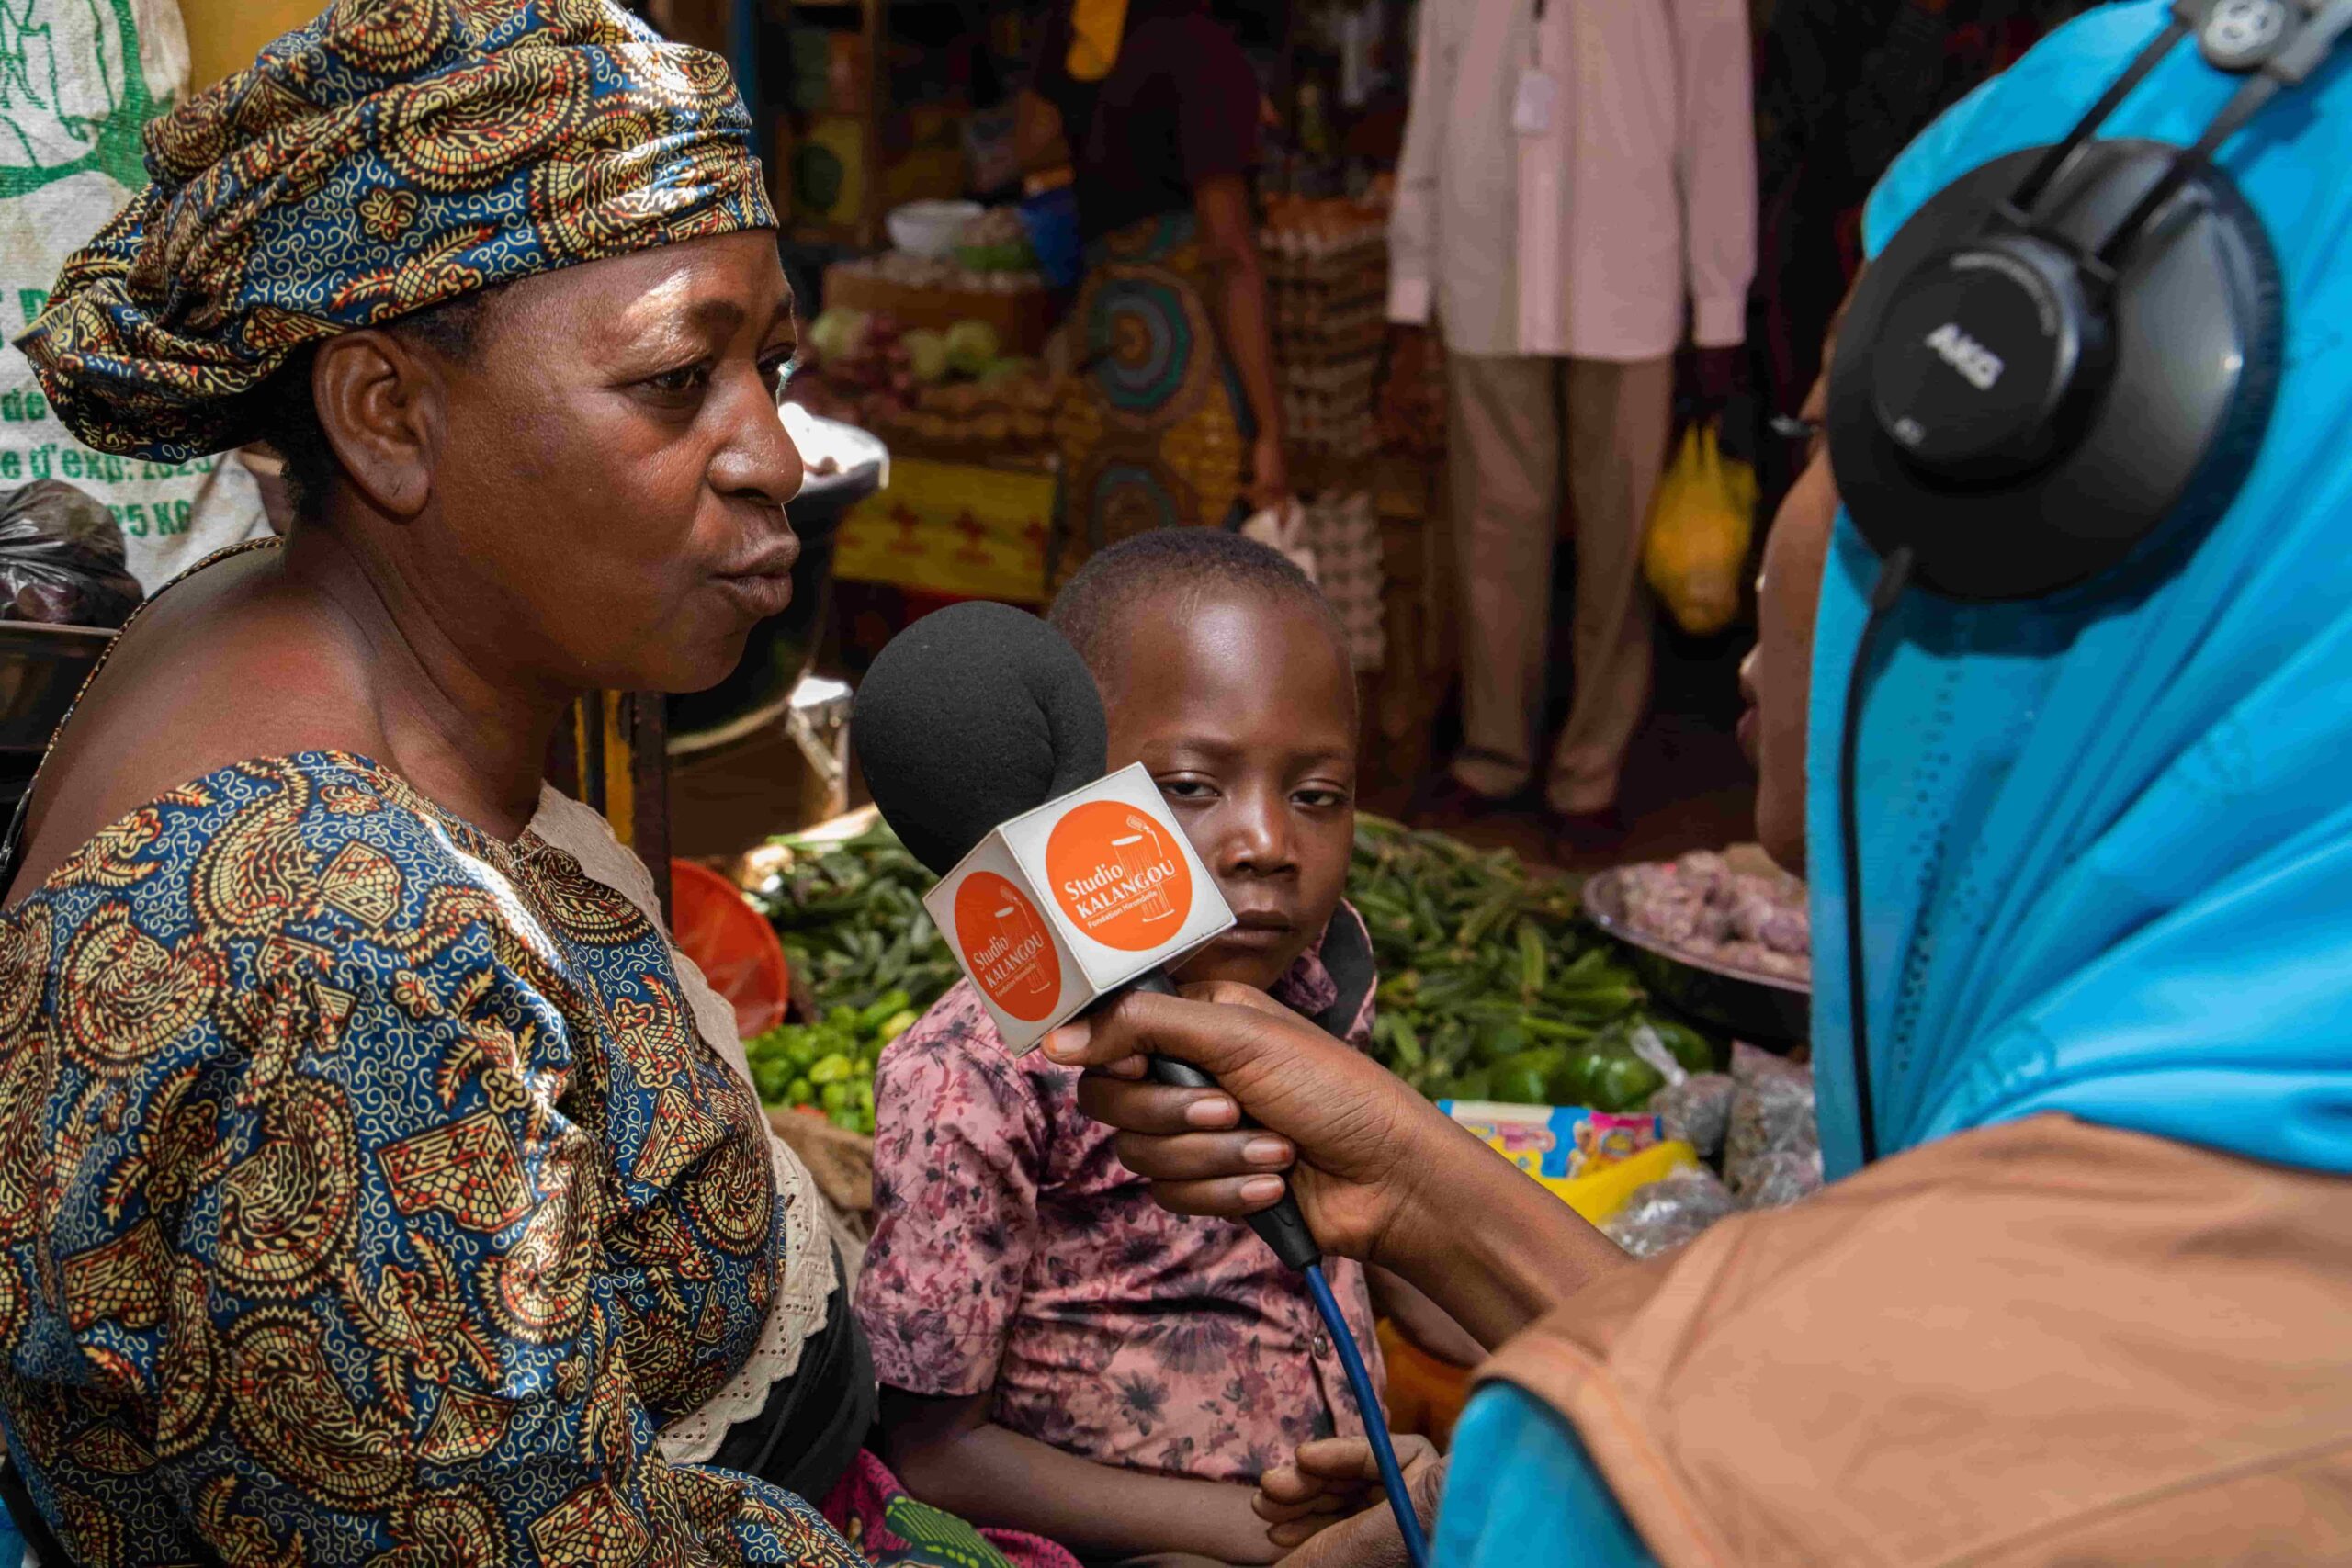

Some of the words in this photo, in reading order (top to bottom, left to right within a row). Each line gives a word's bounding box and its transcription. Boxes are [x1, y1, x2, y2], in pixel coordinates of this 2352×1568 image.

[1064, 863, 1124, 901] Studio
[1075, 859, 1176, 919] KALANGOU
[973, 935, 1009, 972] Studio
[984, 931, 1045, 989] KALANGOU
